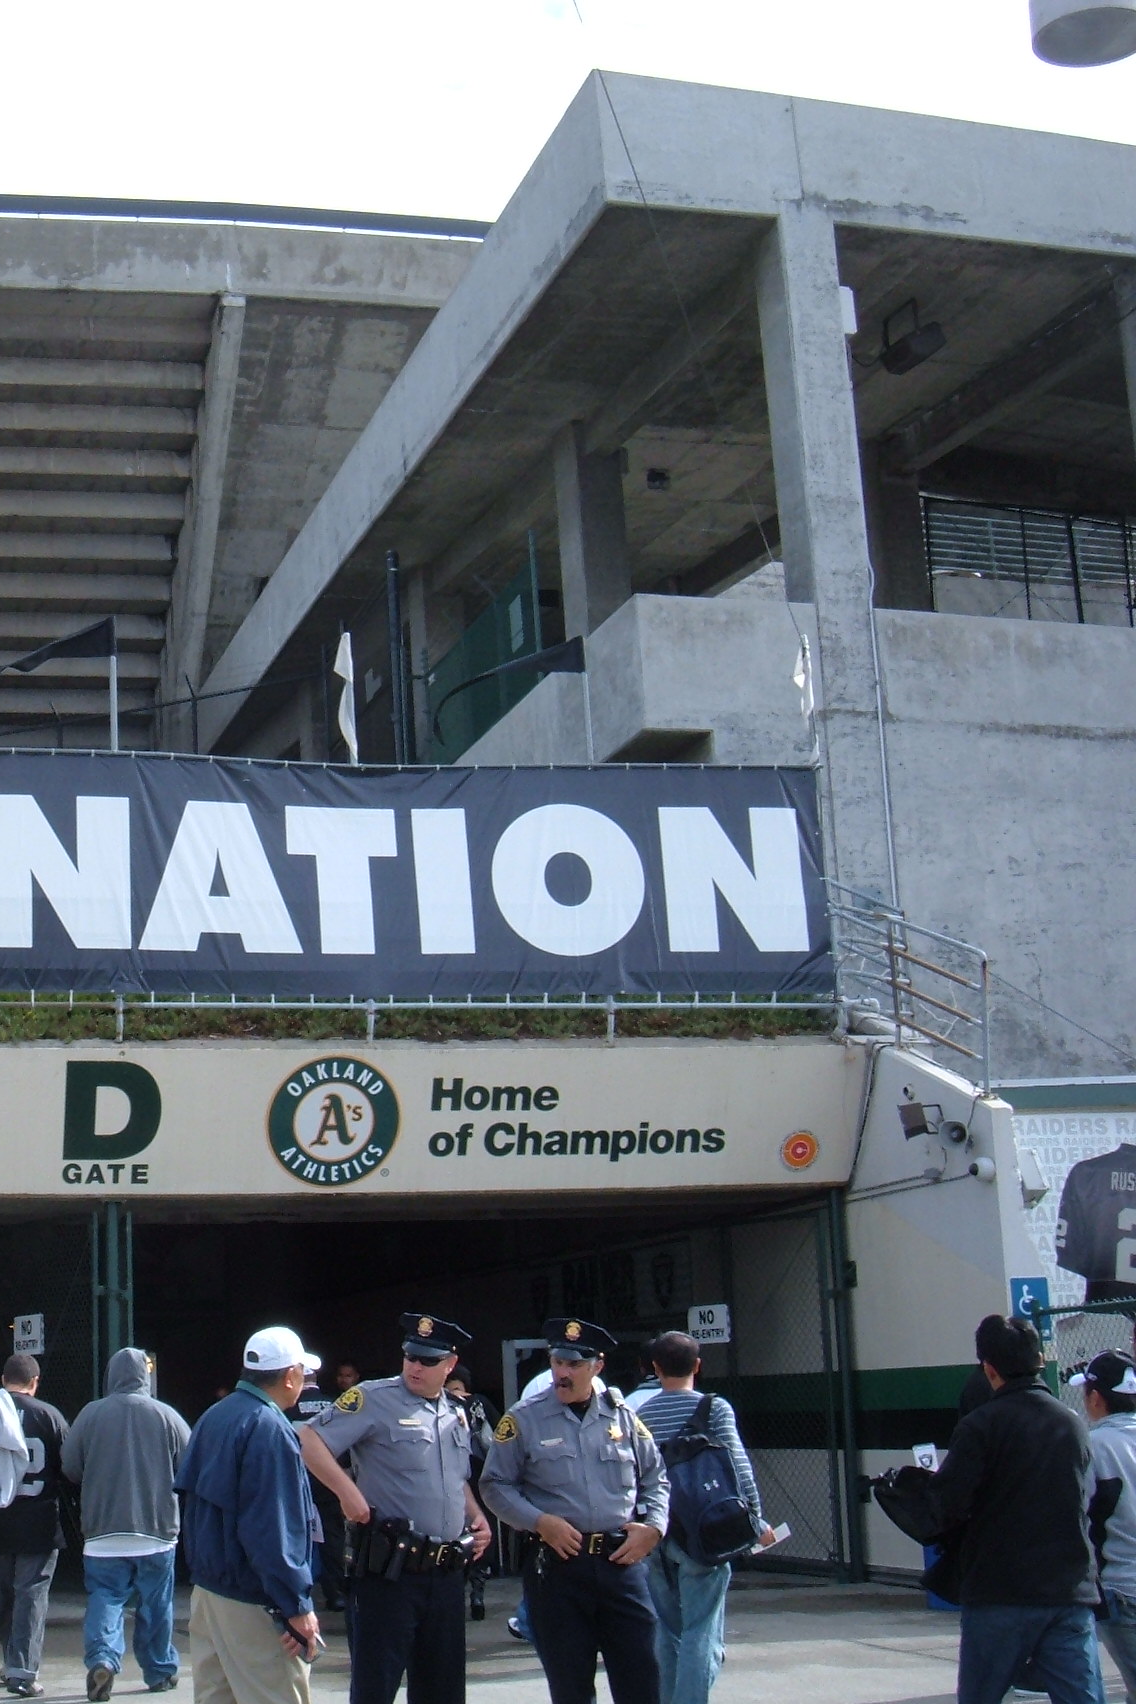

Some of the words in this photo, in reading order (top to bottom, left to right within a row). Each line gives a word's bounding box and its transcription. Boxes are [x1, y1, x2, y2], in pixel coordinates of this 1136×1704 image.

[287, 1062, 384, 1096] OAKLAND
[431, 1078, 559, 1112] Home
[63, 1061, 162, 1160] D
[1014, 1118, 1108, 1136] RAIDERS
[429, 1123, 474, 1157] of
[484, 1122, 726, 1163] Champions
[63, 1164, 149, 1185] GATE
[281, 1144, 383, 1182] ATHLETICS
[21, 1320, 32, 1335] NO
[699, 1310, 714, 1325] NO
